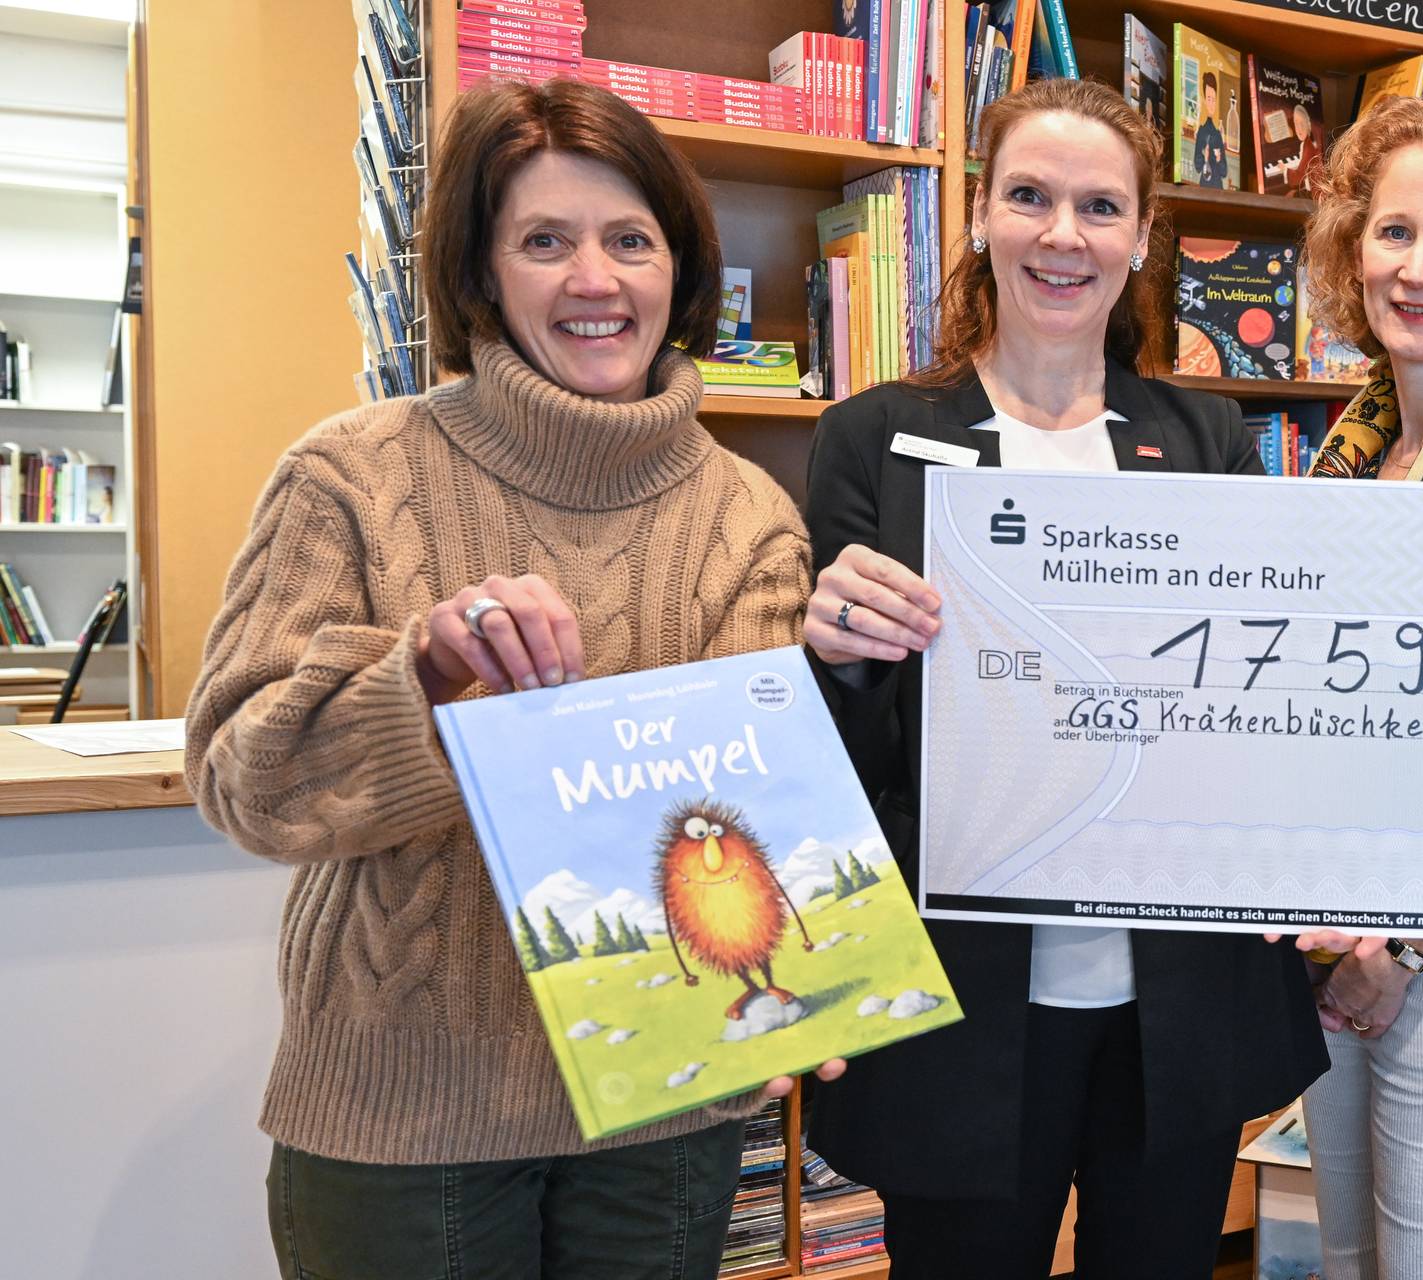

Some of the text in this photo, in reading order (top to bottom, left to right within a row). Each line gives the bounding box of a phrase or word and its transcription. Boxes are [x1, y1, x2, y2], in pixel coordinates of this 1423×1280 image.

[496, 5, 537, 17] Sudoku
[490, 17, 531, 30] Sudoku
[490, 29, 532, 42] Sudoku
[1058, 25, 1069, 47] Herder
[490, 40, 532, 53] Sudoku
[489, 52, 531, 64] Sudoku
[1063, 48, 1074, 67] große
[490, 63, 531, 75] Sudoku
[608, 64, 647, 75] Sudoku
[1068, 68, 1076, 79] Die
[608, 72, 647, 84] Sudoku
[817, 60, 825, 95] Sudoku
[610, 81, 649, 93] Sudoku
[724, 79, 760, 90] Sudoku
[723, 89, 760, 100] Sudoku
[724, 99, 760, 109] Sudoku
[724, 108, 761, 119] Sudoku
[725, 117, 762, 127] Sudoku
[1206, 287, 1272, 303] Im Weltraum
[704, 341, 795, 368] 25
[701, 365, 770, 374] Eckstein
[1042, 524, 1179, 552] Sparkasse
[1042, 559, 1326, 590] Mülheim an der Ruhr
[978, 650, 1041, 681] DE
[751, 687, 790, 695] Mumpel-
[1054, 685, 1184, 699] Betrag in Buchstaben
[1068, 698, 1139, 730] GGS
[1054, 718, 1069, 727] an
[613, 716, 676, 750] Der
[1053, 730, 1159, 745] oder Überbringer
[551, 723, 768, 812] Mumpel
[1074, 903, 1093, 914] Bei
[1095, 904, 1136, 916] diesem
[1139, 905, 1178, 917] Scheck
[1180, 907, 1224, 919] handelt
[1226, 910, 1239, 920] es
[1242, 909, 1265, 921] sich
[1267, 911, 1286, 922] um
[1288, 911, 1320, 923] einen
[1323, 912, 1394, 925] Dekoscheck,
[1396, 914, 1415, 925] der
